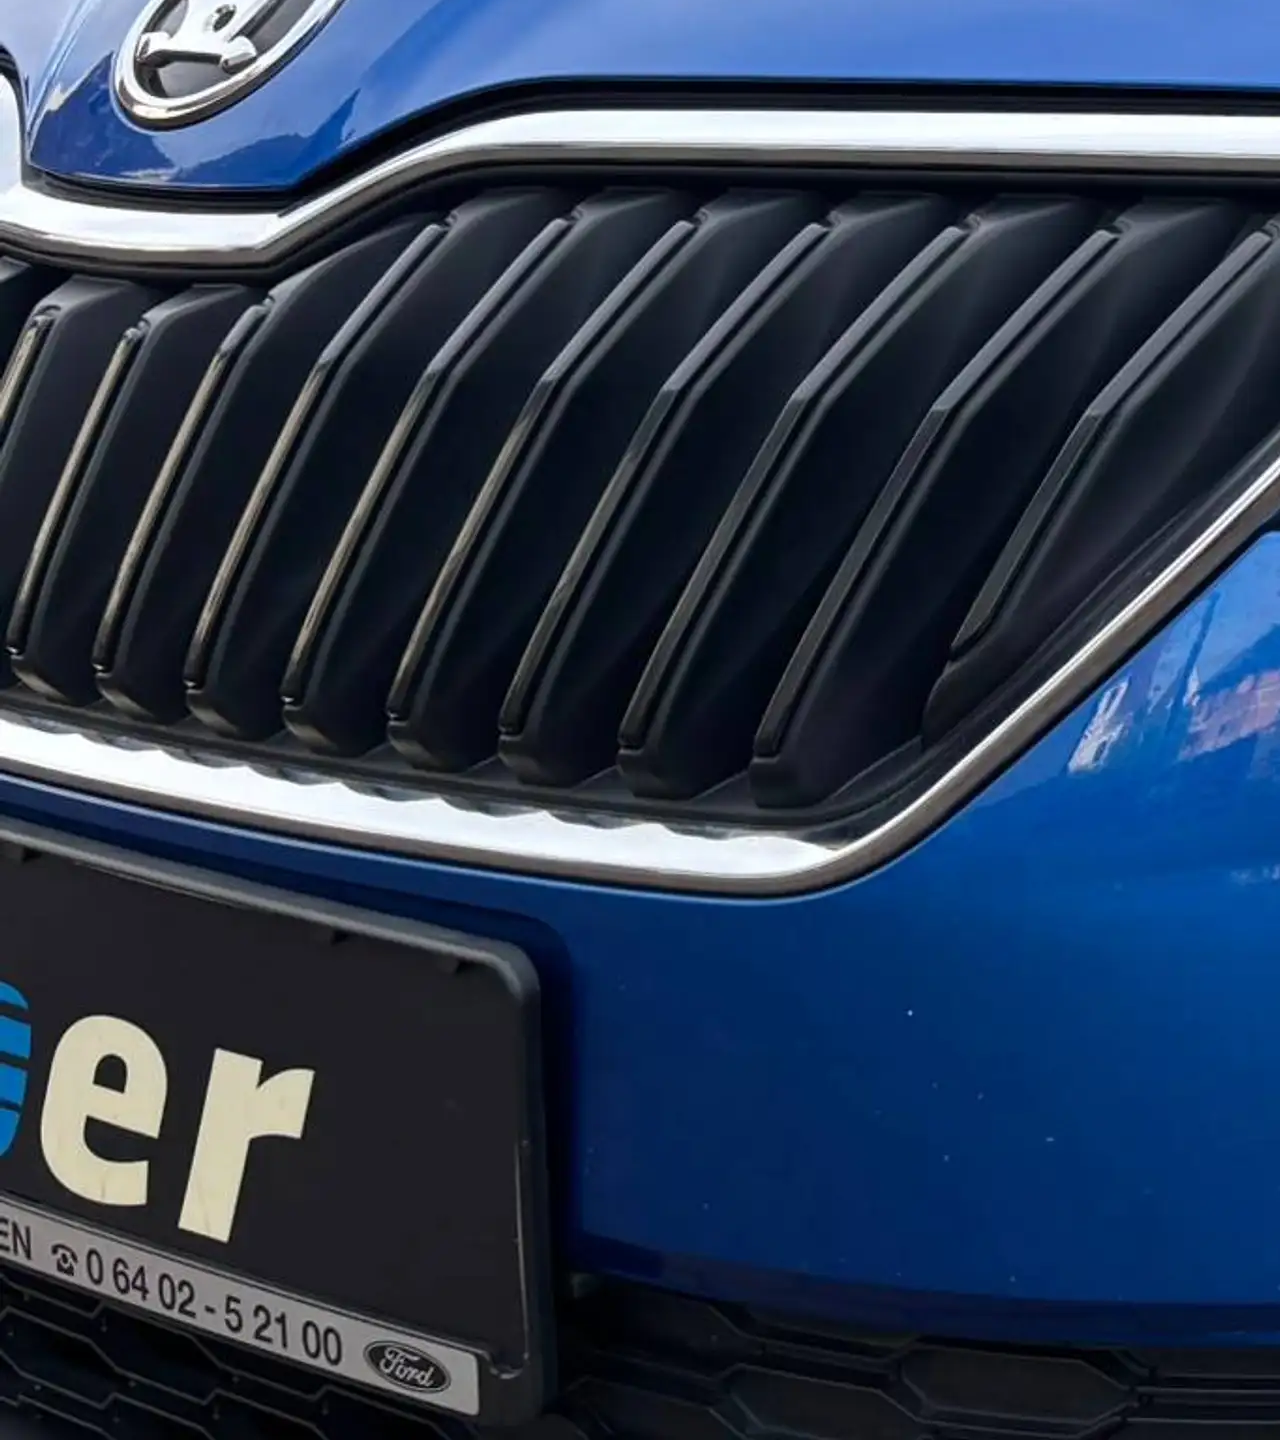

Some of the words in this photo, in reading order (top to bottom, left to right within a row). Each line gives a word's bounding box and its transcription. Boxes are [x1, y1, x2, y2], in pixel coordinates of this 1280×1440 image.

[86, 1248, 103, 1285] 0
[113, 1258, 149, 1301] 64
[159, 1273, 196, 1318] 02
[224, 1295, 243, 1333] 5
[253, 1305, 287, 1349] 21
[303, 1320, 342, 1366] 00
[379, 1347, 436, 1387] Ford
